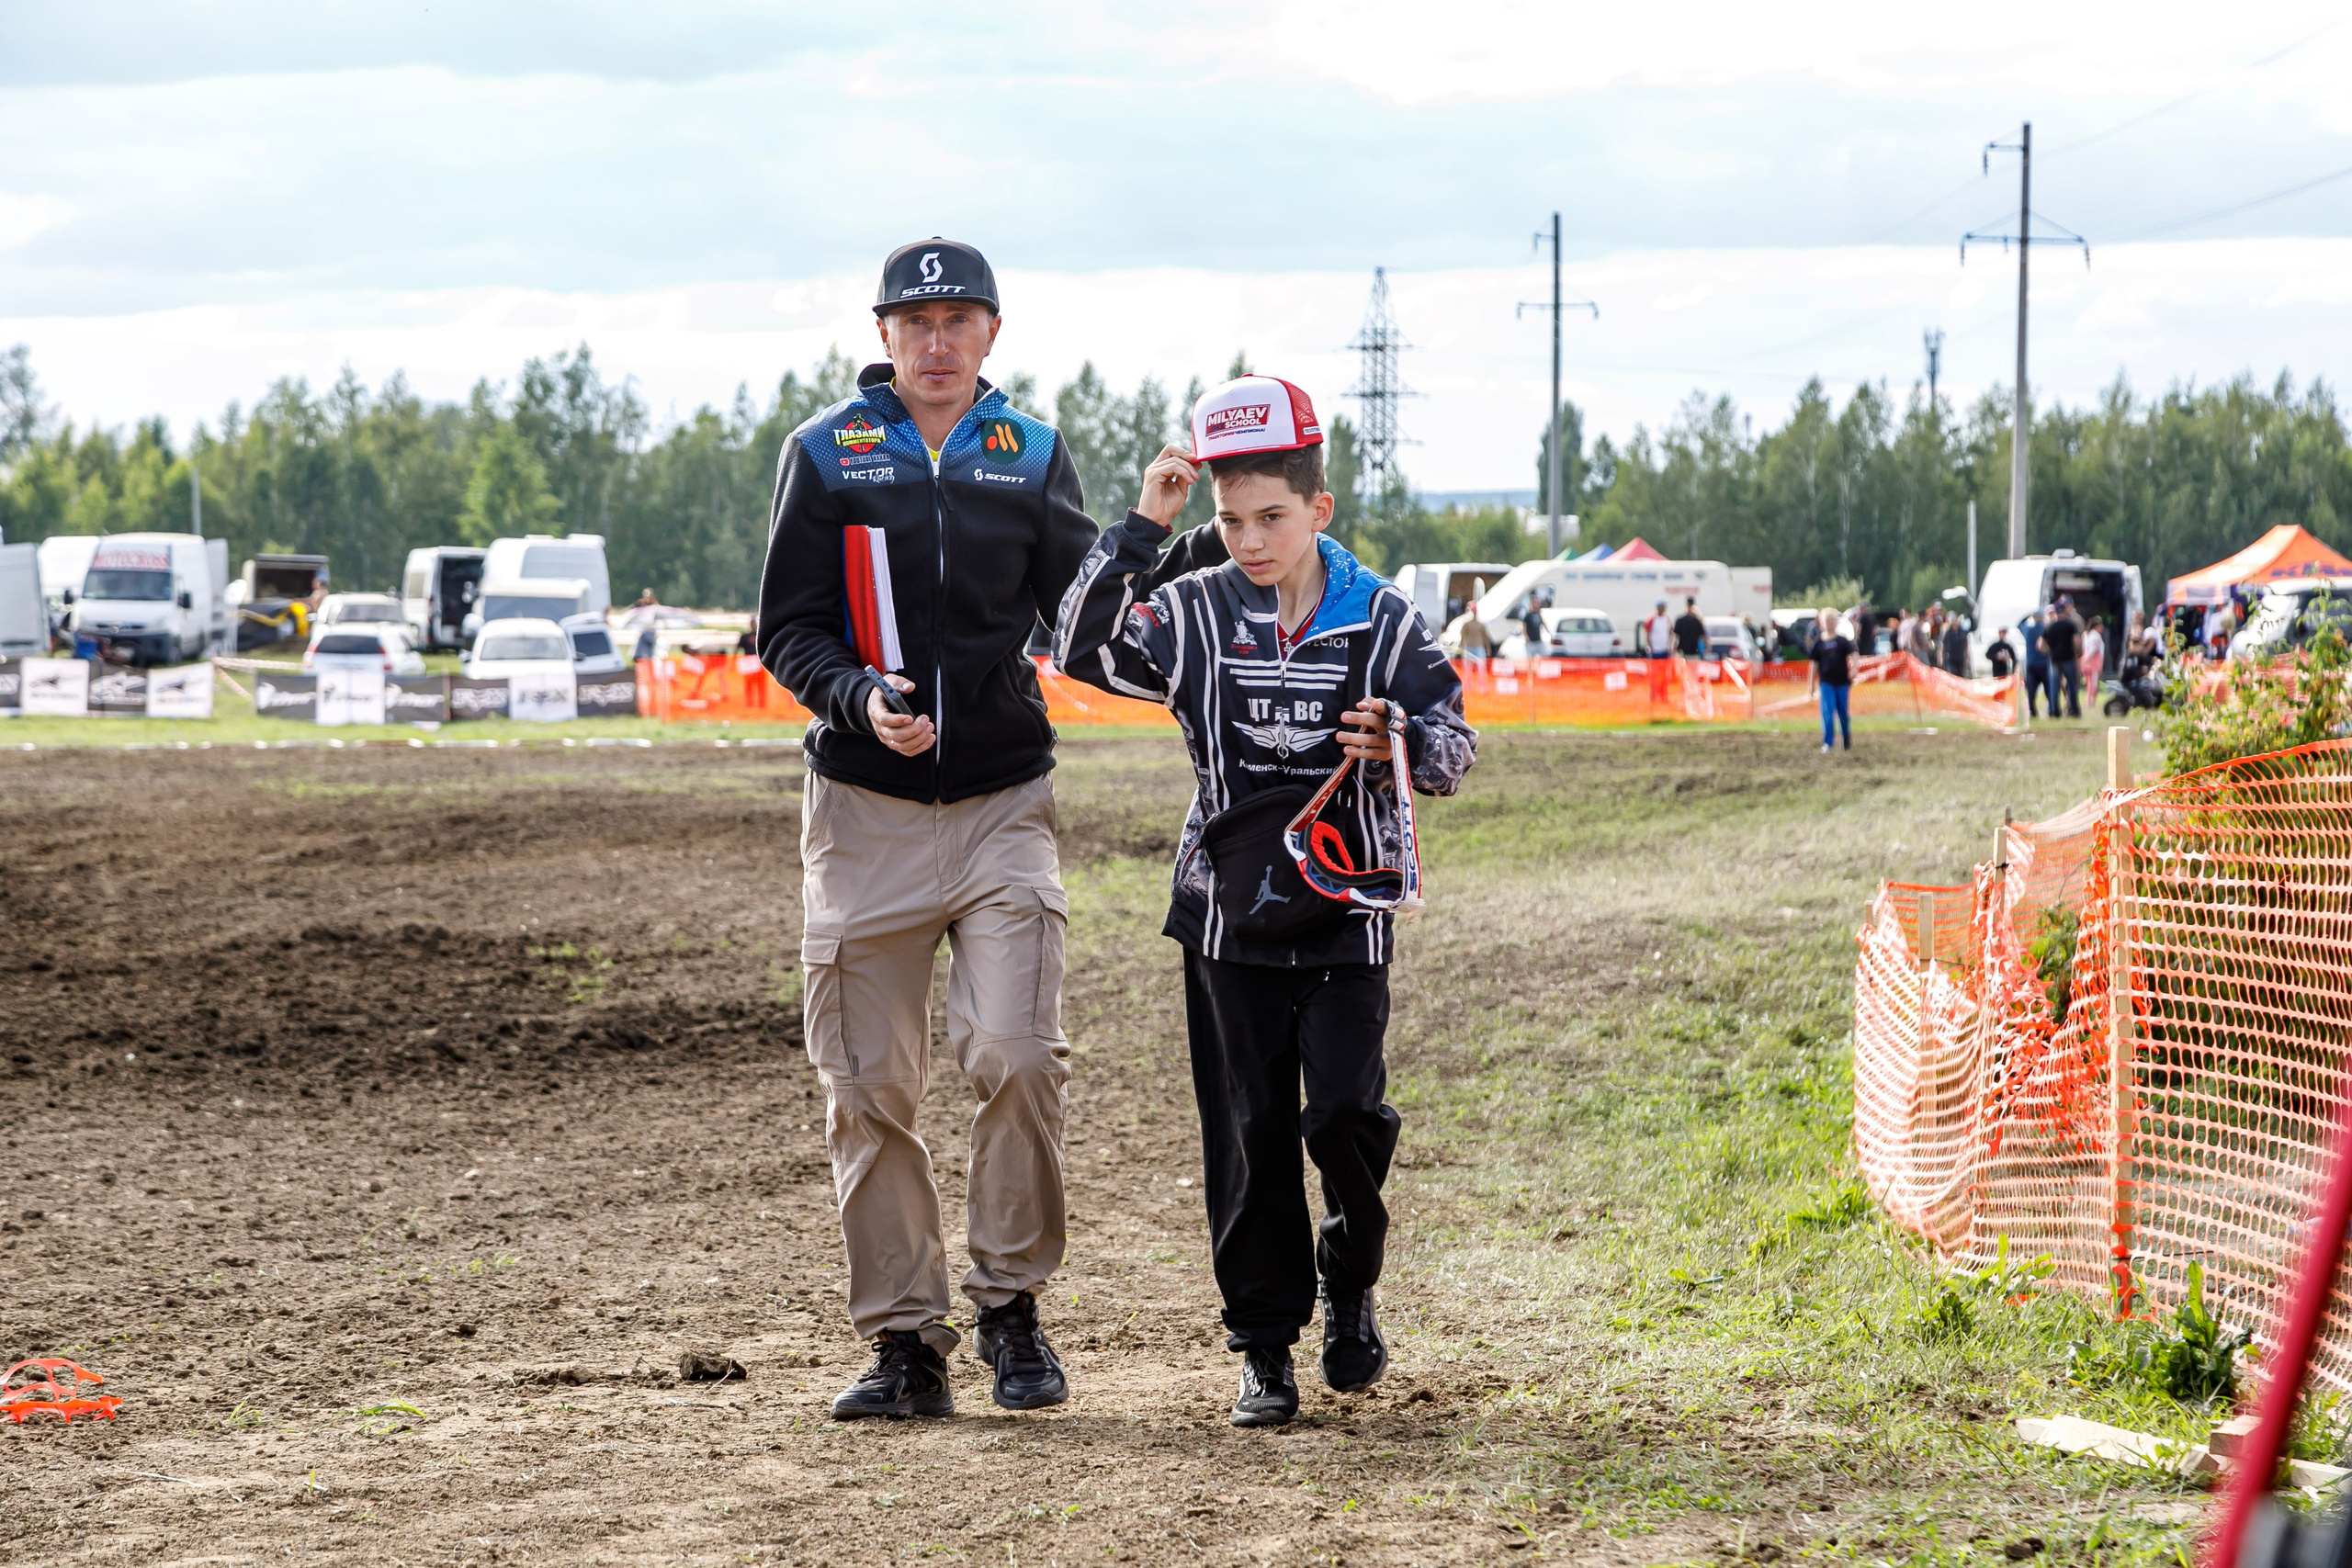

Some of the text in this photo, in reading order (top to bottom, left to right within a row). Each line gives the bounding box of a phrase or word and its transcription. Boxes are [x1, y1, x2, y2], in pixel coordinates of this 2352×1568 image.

[900, 285, 966, 299] SCOTT
[1207, 407, 1268, 427] MILYAEV
[1225, 418, 1261, 429] SCHOOL
[833, 425, 887, 446] ГЛАЗАМИ
[842, 467, 894, 480] VECTOR
[984, 473, 1027, 484] SCOTT
[1306, 636, 1349, 649] ECTO
[1248, 698, 1323, 722] ЦТ ВС
[1238, 758, 1338, 776] Кменск-Уральски
[1401, 795, 1418, 892] SCOTT
